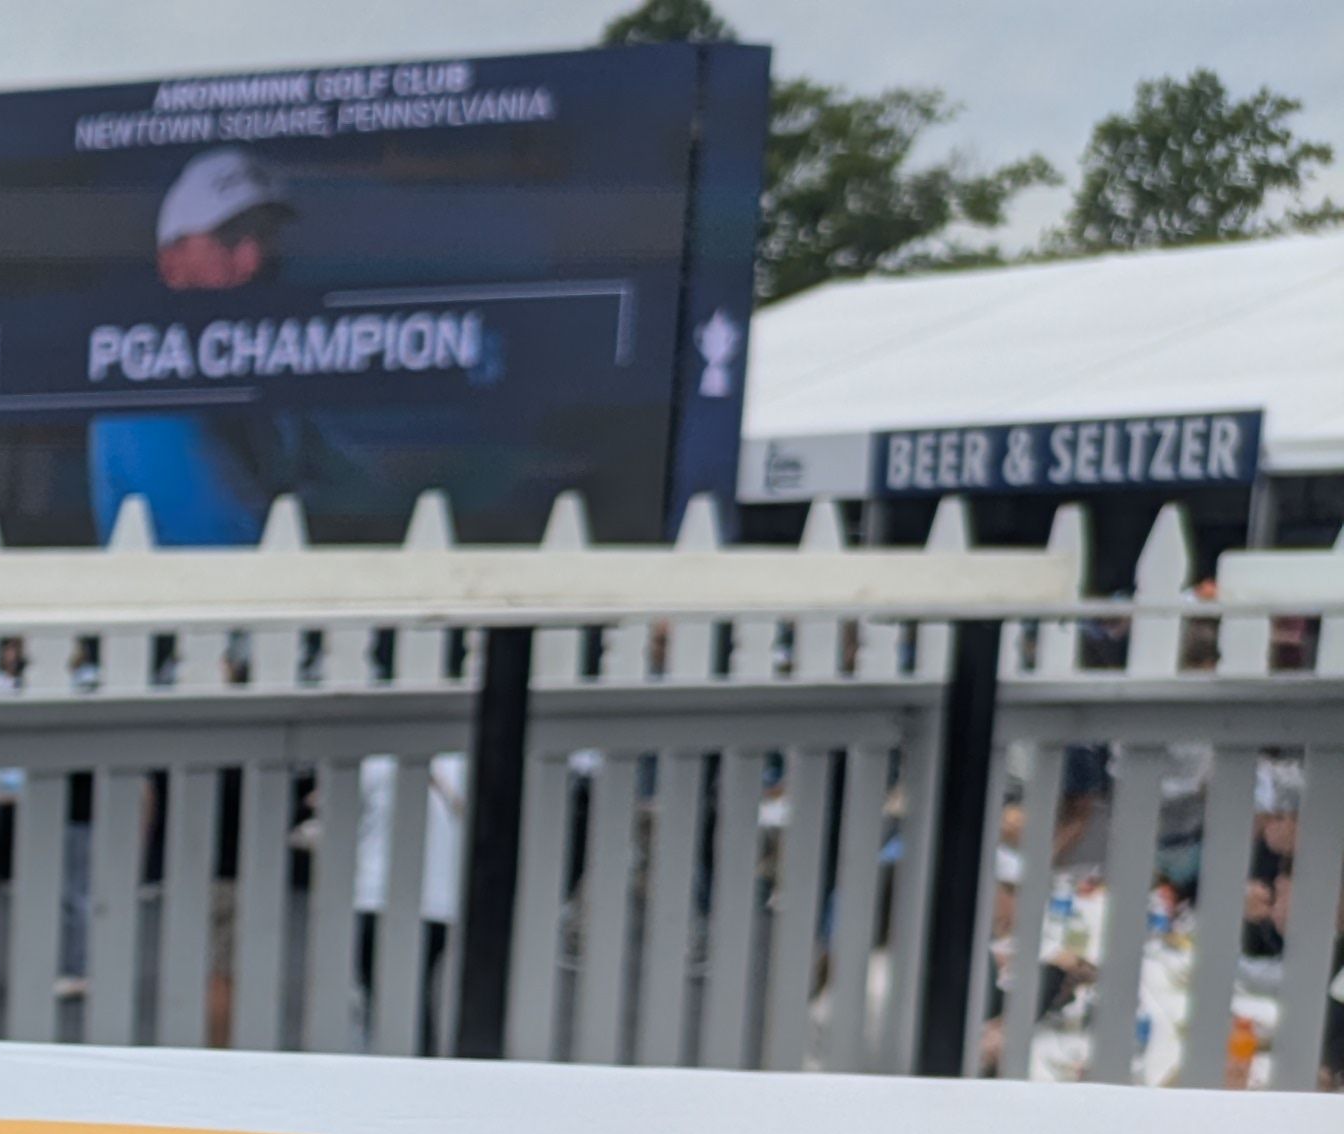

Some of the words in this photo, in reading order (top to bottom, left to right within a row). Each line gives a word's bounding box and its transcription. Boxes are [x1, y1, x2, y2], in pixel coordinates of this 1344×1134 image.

[316, 68, 389, 99] GOLF
[392, 62, 473, 96] CLUB
[74, 111, 211, 151] NEWTOWN
[218, 105, 335, 141] SQUARE,
[336, 87, 555, 132] PENNSYLVANIA
[88, 322, 190, 382] PGA
[195, 310, 483, 378] CHAMPION
[886, 431, 989, 490] BEER
[1002, 429, 1035, 486] &
[1048, 416, 1241, 484] SELTZER
